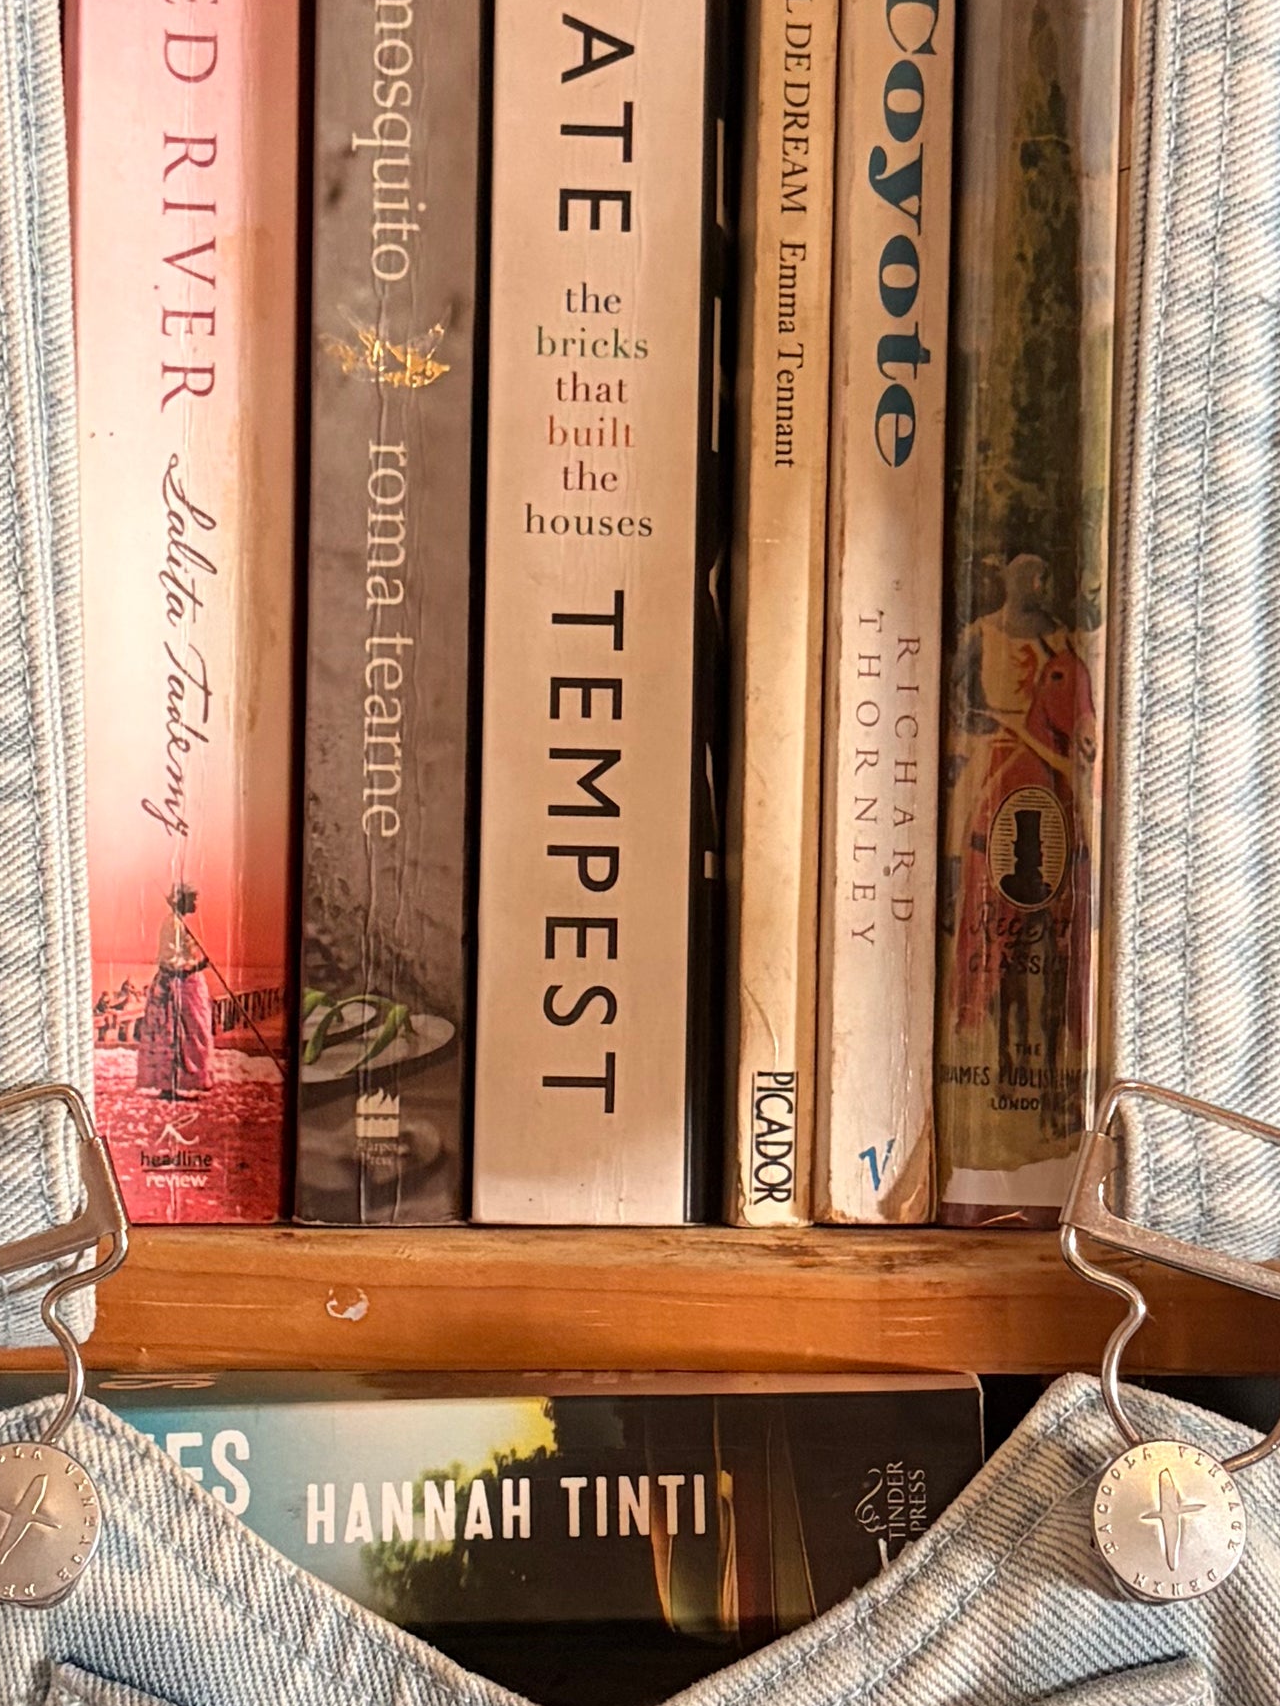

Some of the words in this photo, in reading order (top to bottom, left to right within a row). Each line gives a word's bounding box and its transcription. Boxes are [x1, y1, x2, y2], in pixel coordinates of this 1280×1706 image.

[784, 21, 813, 71] DE
[781, 77, 812, 214] DREAM
[160, 131, 219, 413] RIVER
[565, 281, 622, 315] the
[778, 239, 808, 335] Emma
[535, 325, 649, 360] bricks
[553, 373, 629, 405] that
[775, 345, 805, 470] Tennant
[546, 414, 636, 449] built
[561, 461, 619, 494] the
[160, 452, 219, 629] Lalita
[366, 439, 410, 612] roma
[525, 503, 654, 538] houses
[141, 637, 211, 839] Tademy
[851, 609, 885, 947] THORNLEY
[891, 634, 922, 925] RICHARD
[541, 589, 625, 1114] TEMPEST
[140, 1151, 213, 1170] headline
[754, 1071, 795, 1204] PICADOR
[145, 1173, 208, 1190] review
[305, 1475, 532, 1544] HANNAH
[564, 1471, 709, 1537] TINTI
[885, 1460, 907, 1542] TINDER
[908, 1469, 928, 1532] PRESS
